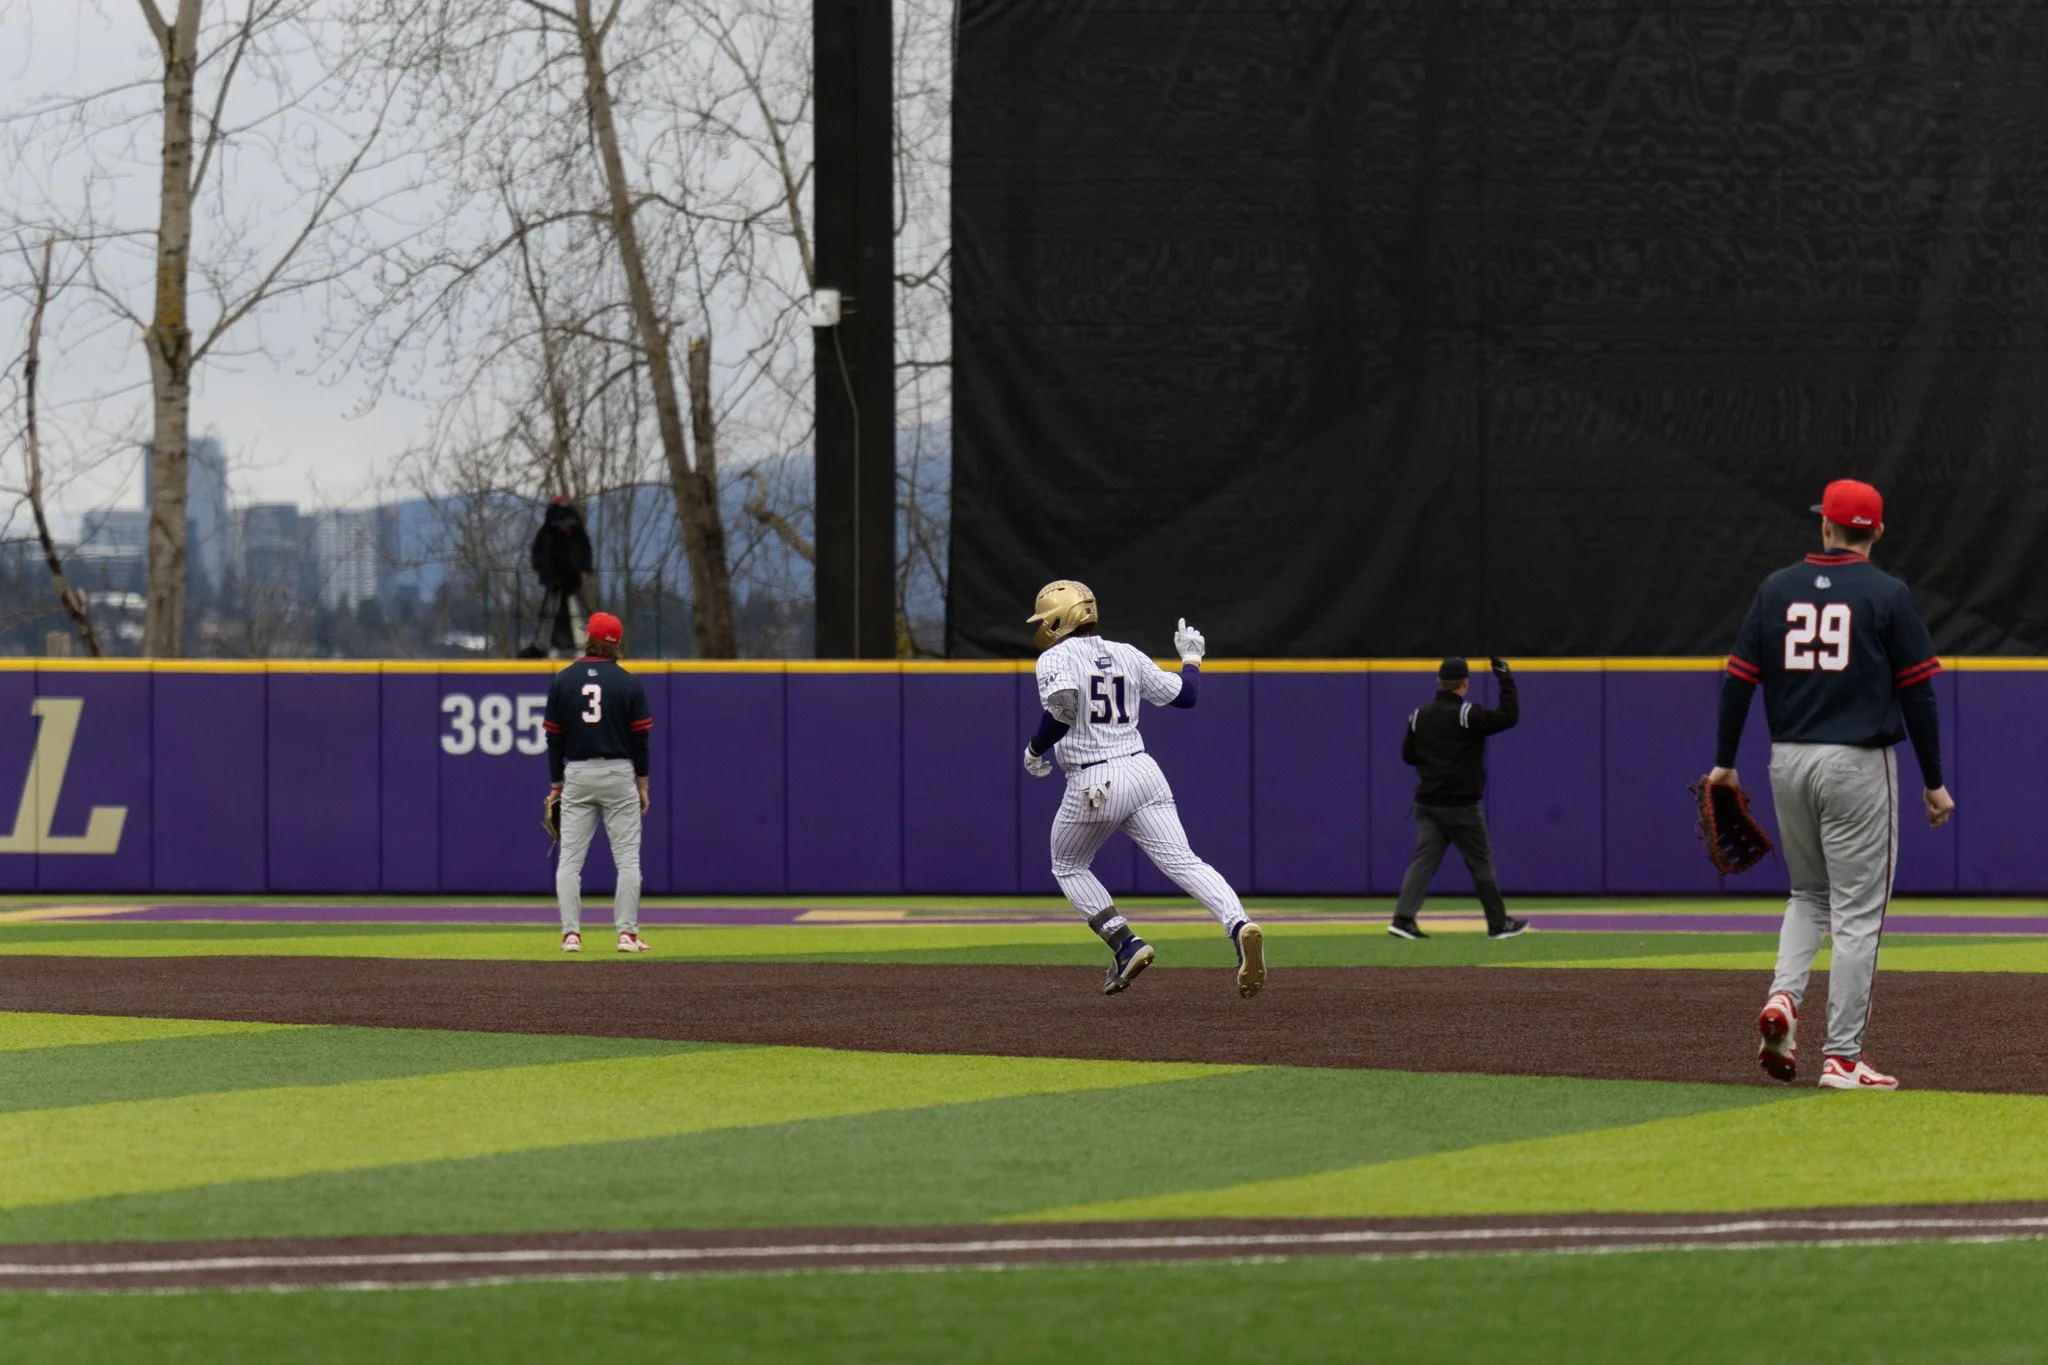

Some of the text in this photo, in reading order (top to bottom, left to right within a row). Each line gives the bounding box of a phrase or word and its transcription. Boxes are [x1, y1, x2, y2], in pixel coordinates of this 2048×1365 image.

[1784, 602, 1851, 671] 29
[441, 693, 548, 756] 385
[581, 684, 602, 723] 3
[1089, 674, 1130, 724] 51
[0, 696, 128, 855] L
